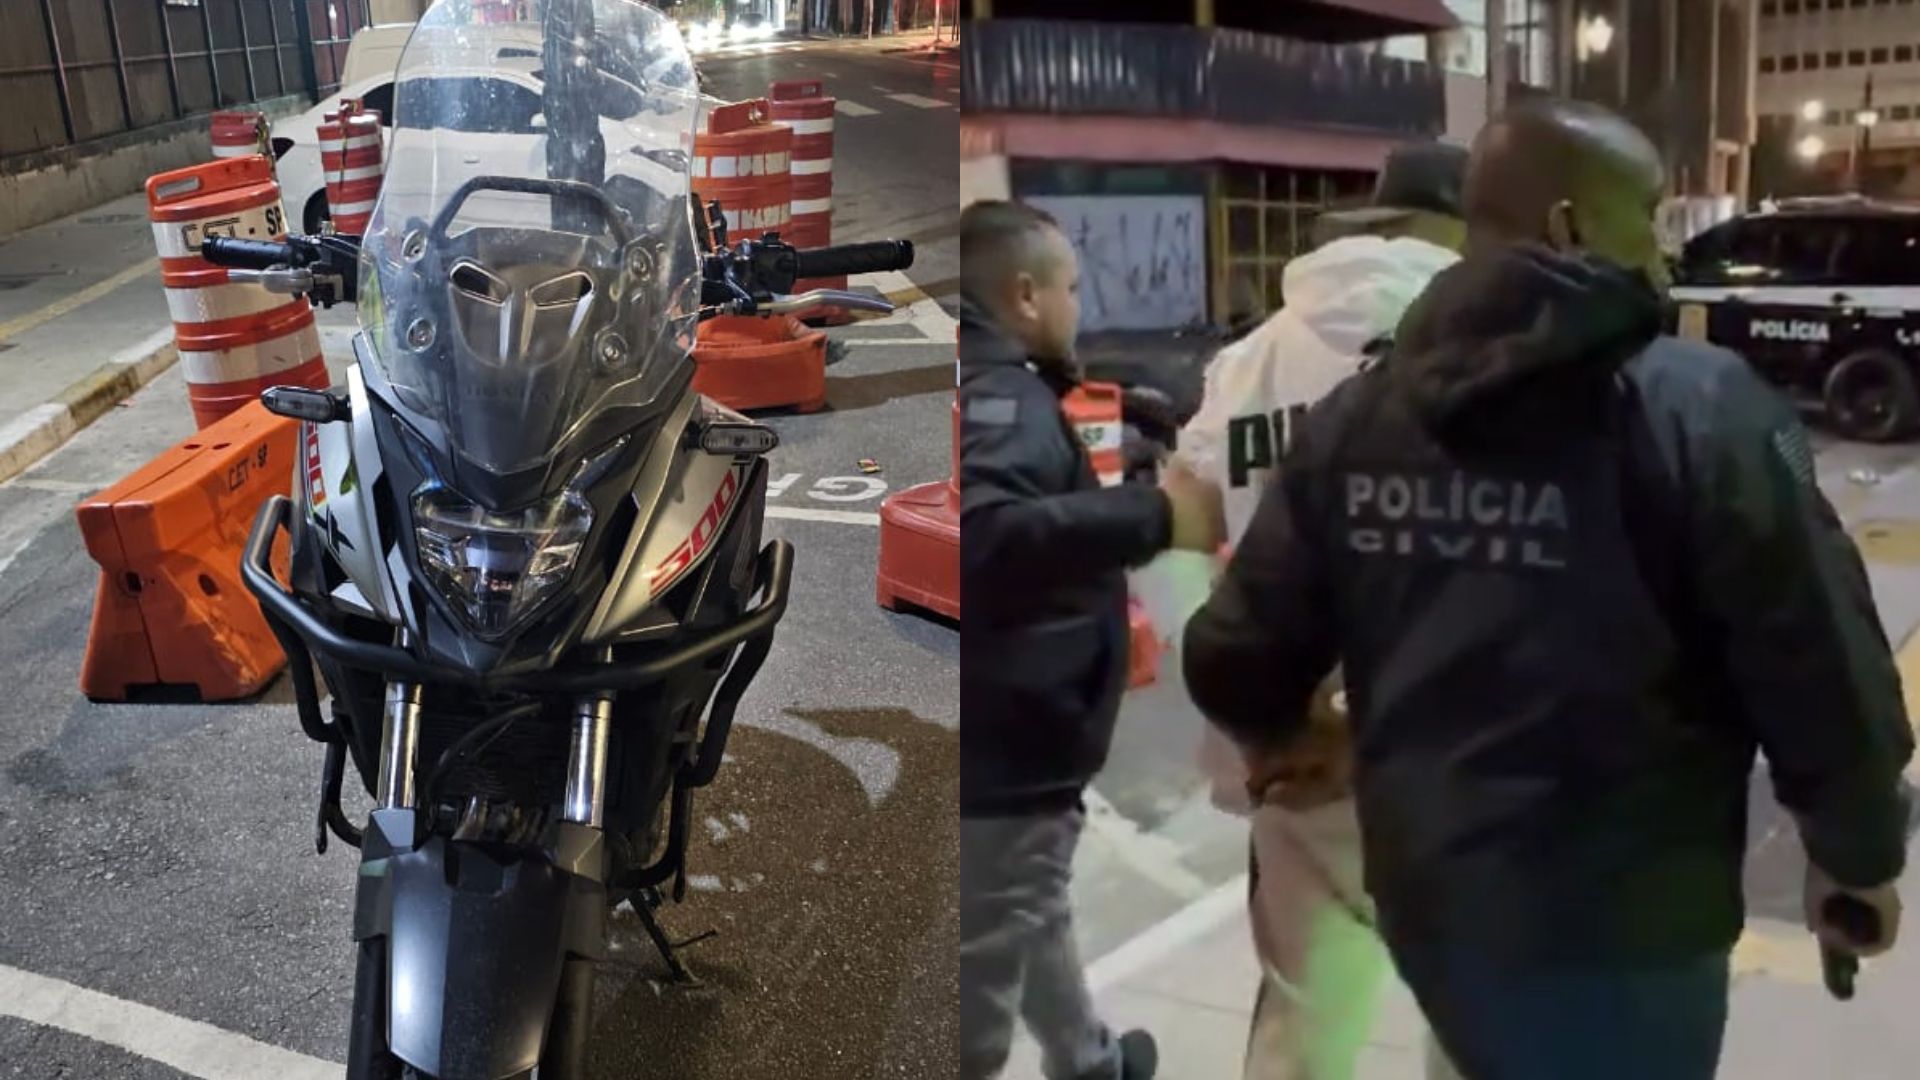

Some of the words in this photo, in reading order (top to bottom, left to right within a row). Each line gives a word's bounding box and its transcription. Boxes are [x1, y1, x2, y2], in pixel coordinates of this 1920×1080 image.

[264, 205, 283, 235] SP
[1749, 317, 1830, 343] POLÍCIA
[228, 450, 250, 491] CET
[1345, 470, 1568, 530] POLÍCIA
[650, 469, 737, 598] 500
[1348, 529, 1567, 569] CIVIL
